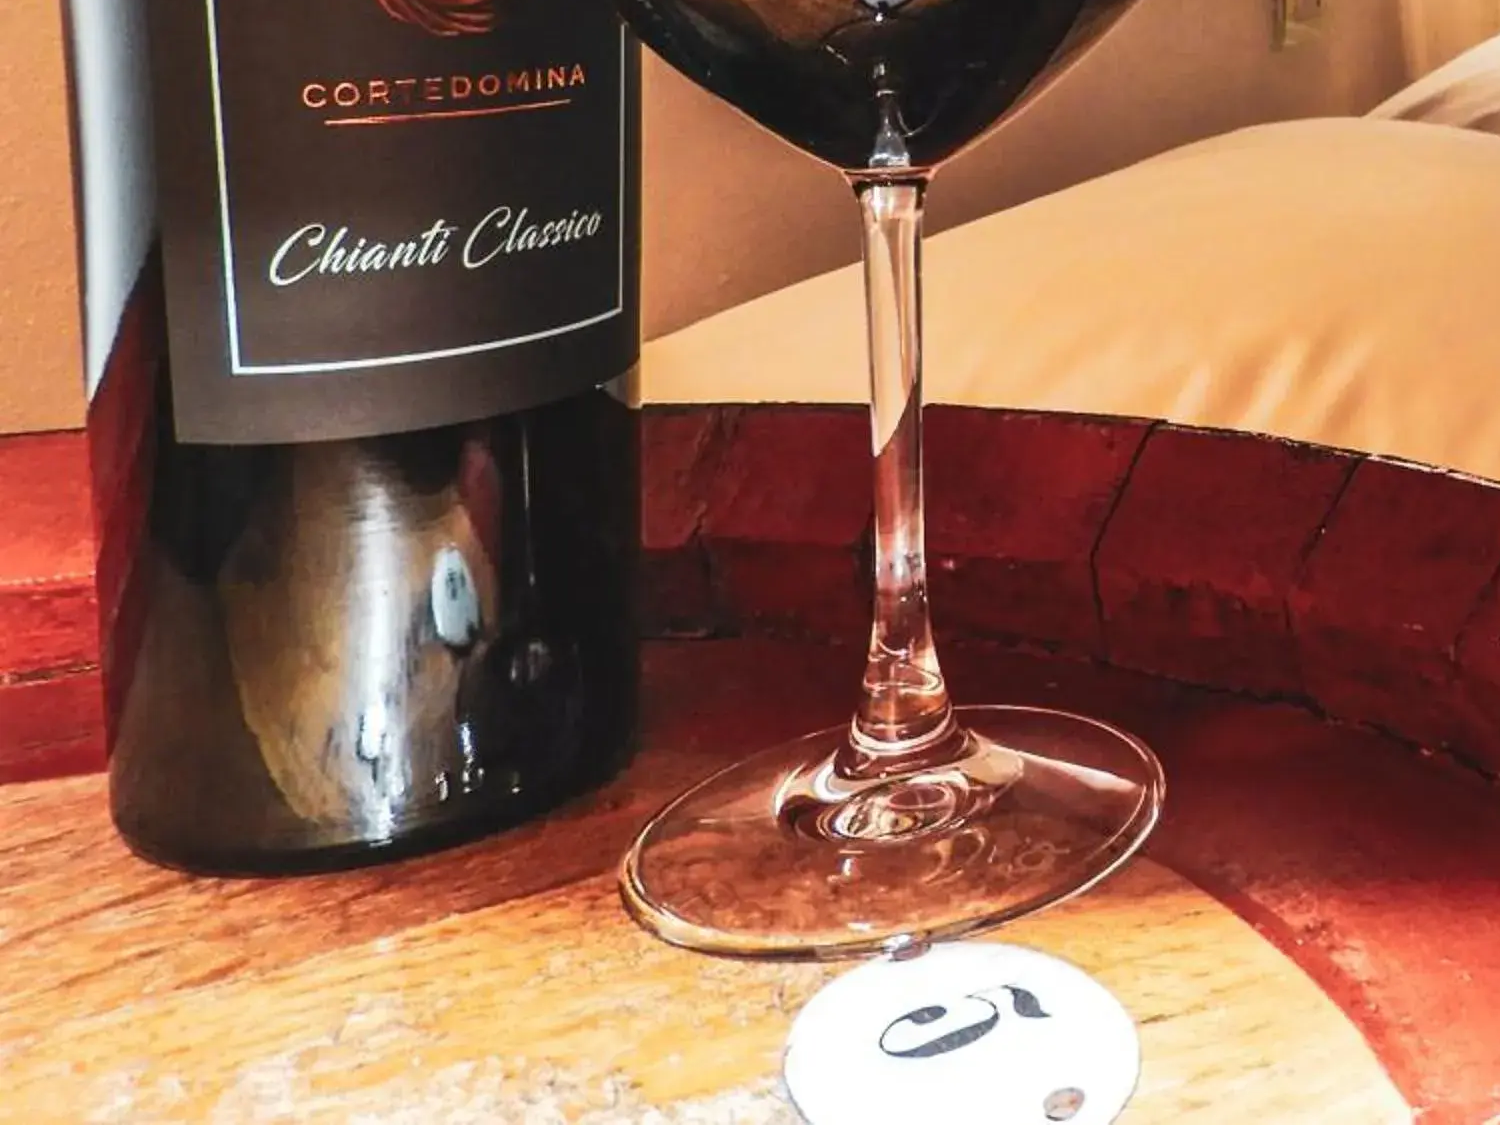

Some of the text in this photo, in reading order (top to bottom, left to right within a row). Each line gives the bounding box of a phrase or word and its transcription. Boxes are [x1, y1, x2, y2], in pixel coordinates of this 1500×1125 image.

[303, 62, 587, 109] CORTEDOMINA
[268, 205, 603, 288] Chianti Classico
